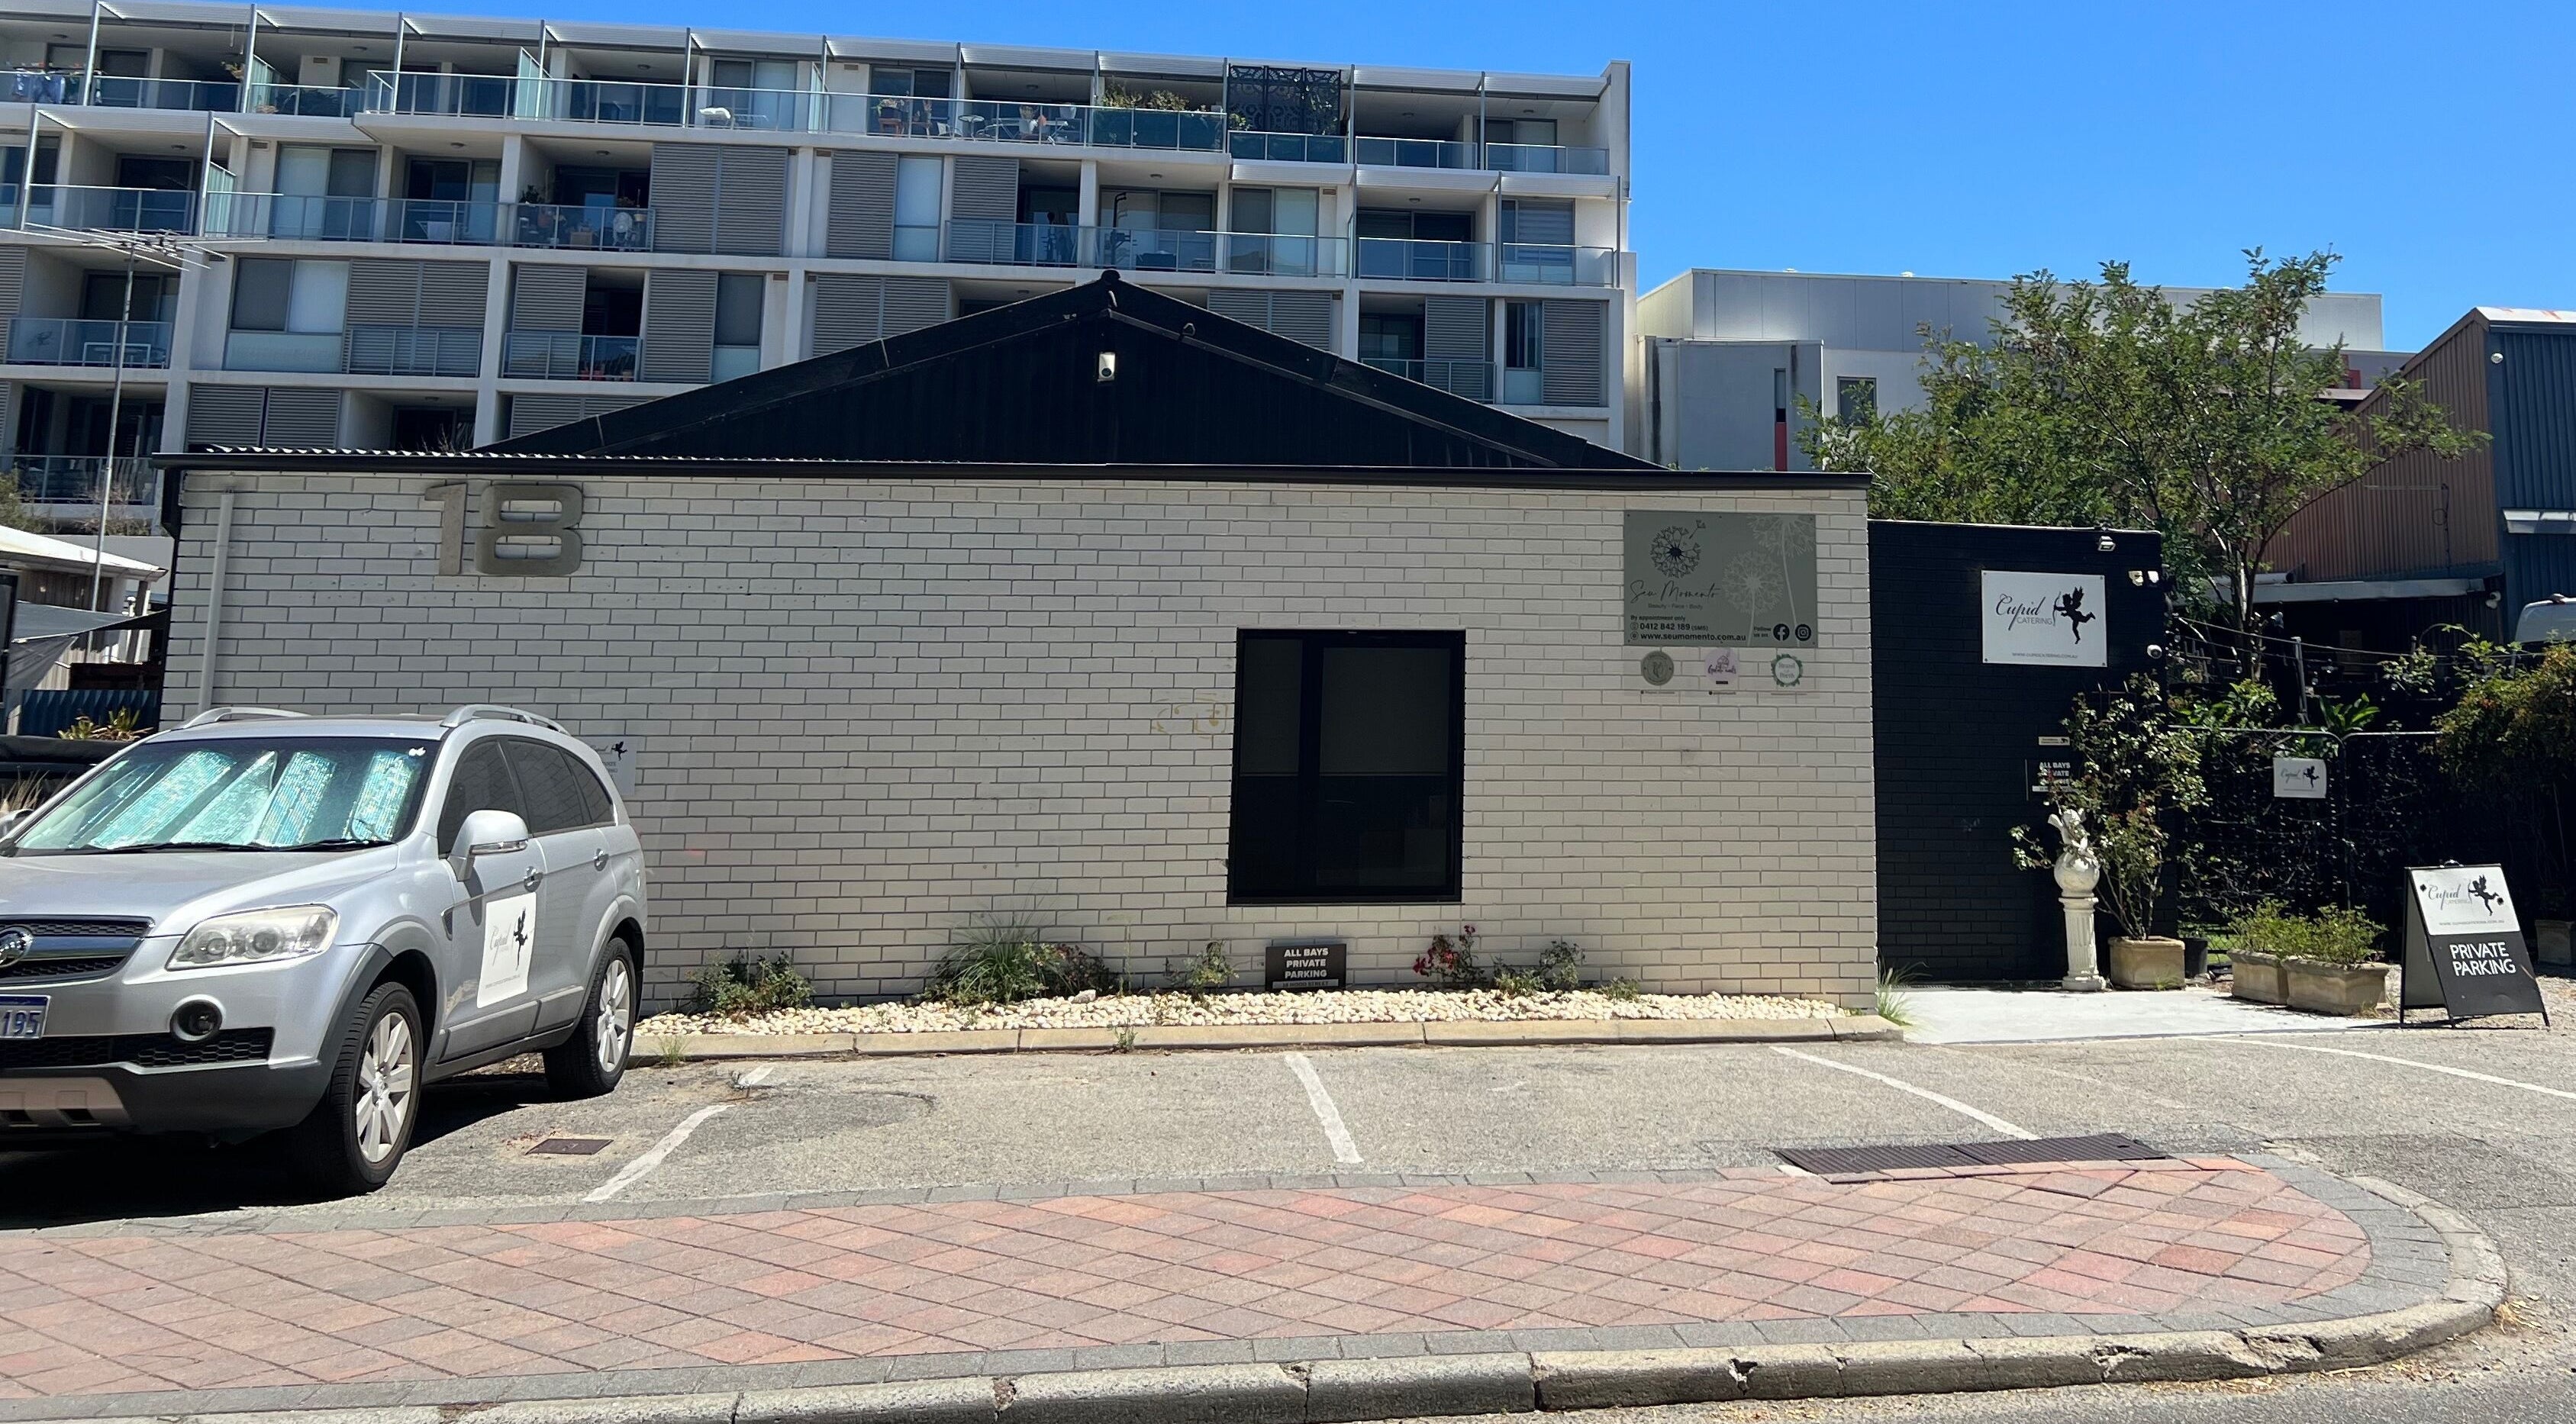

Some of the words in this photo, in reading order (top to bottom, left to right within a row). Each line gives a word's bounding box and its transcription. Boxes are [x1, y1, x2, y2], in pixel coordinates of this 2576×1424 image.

[424, 483, 583, 576] 18
[1996, 593, 2046, 631] Cupid
[2017, 617, 2053, 625] CATERING
[2428, 884, 2461, 910] Cupid
[1304, 948, 1328, 956] BAYS
[2449, 942, 2509, 959] PRIVATE
[1286, 958, 1326, 968] PRIVATE
[2452, 958, 2516, 976] PARKING
[1285, 969, 1327, 978] PARKING
[2, 1010, 41, 1036] 195
